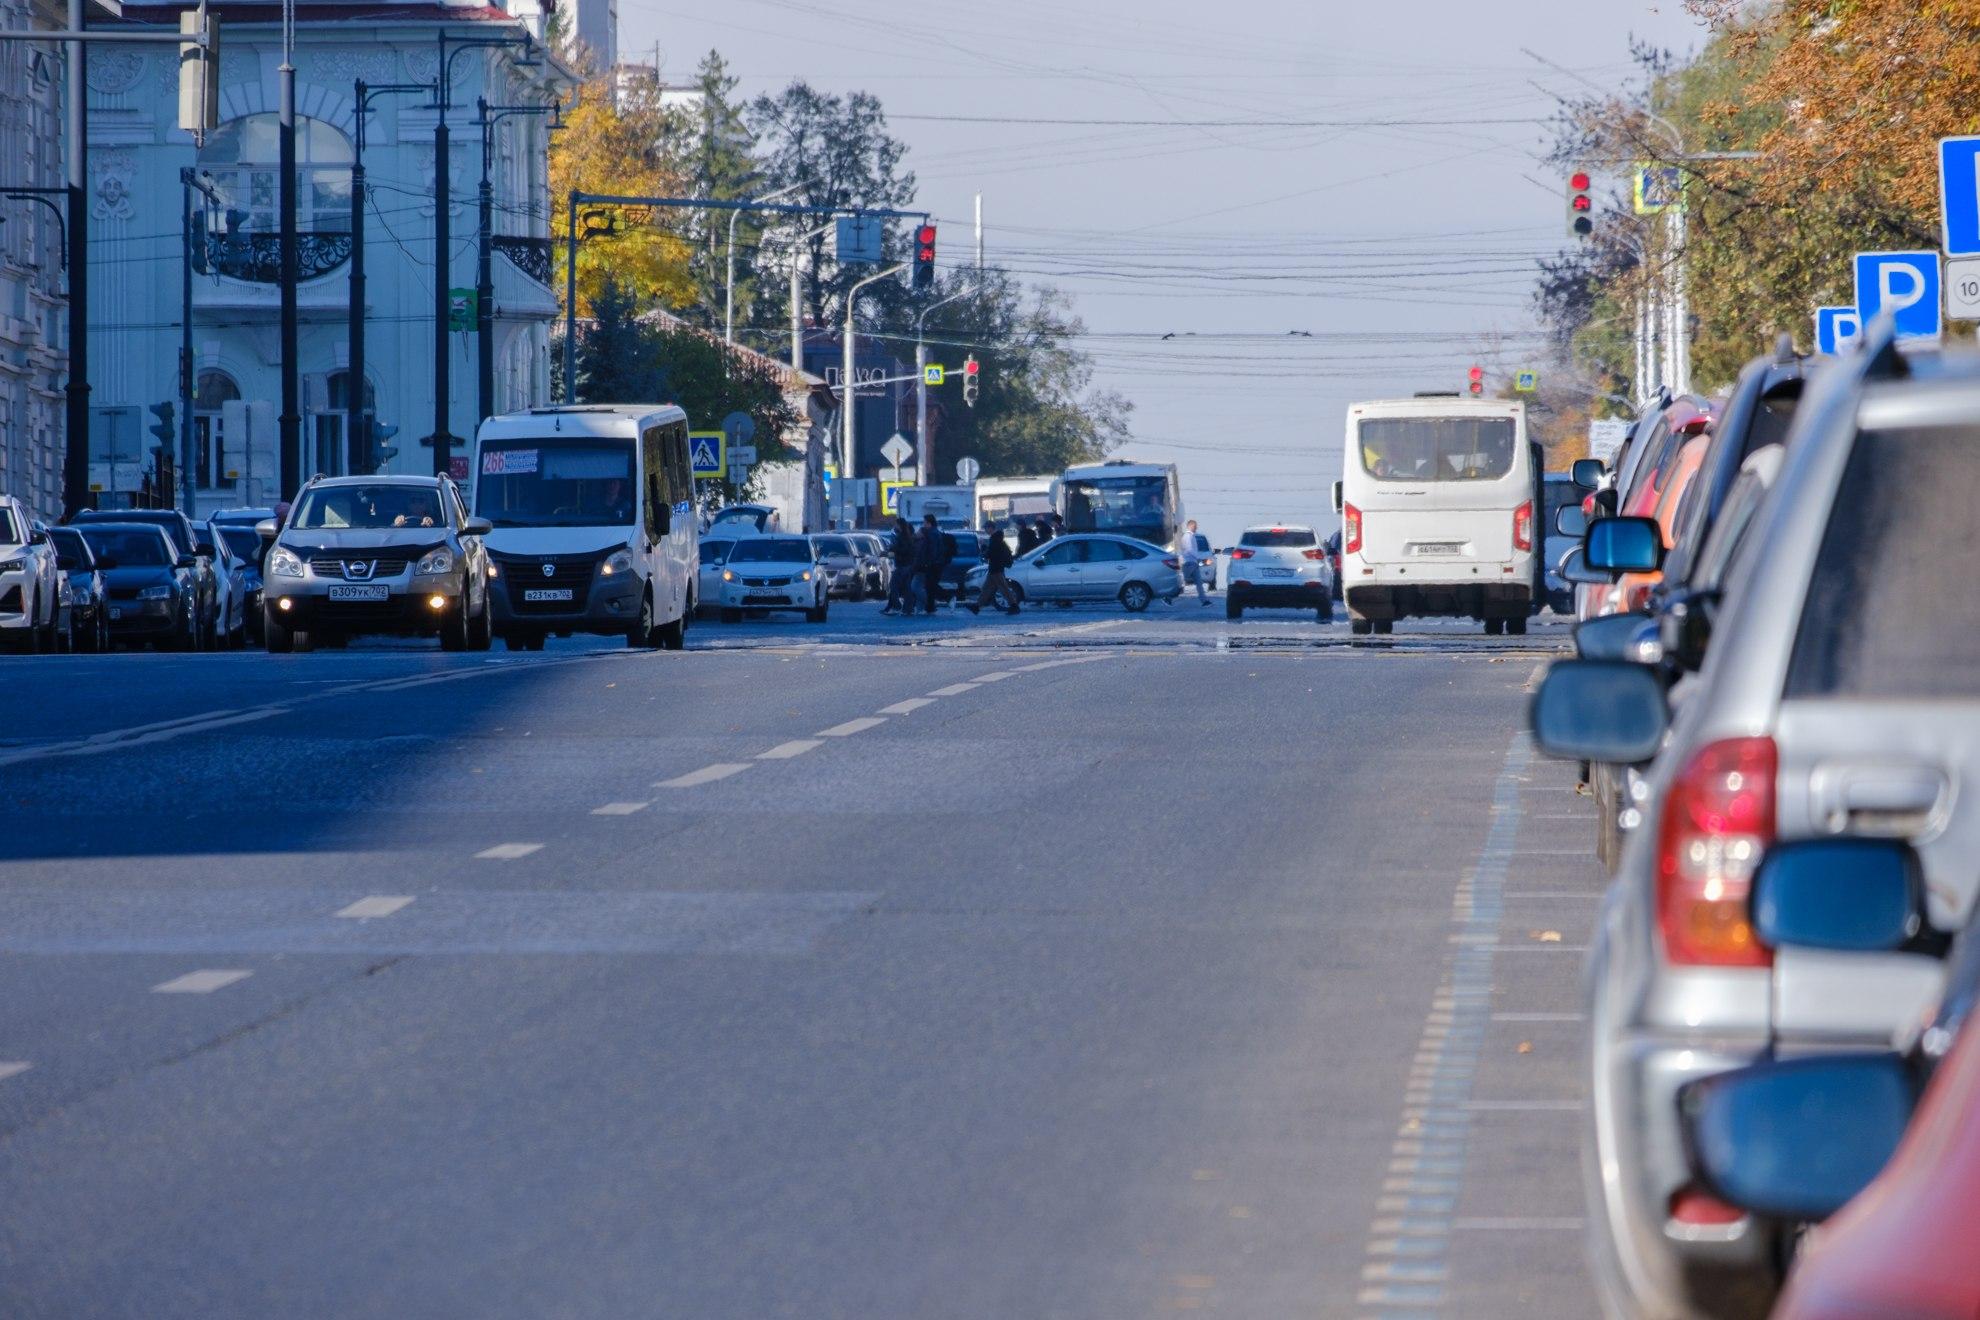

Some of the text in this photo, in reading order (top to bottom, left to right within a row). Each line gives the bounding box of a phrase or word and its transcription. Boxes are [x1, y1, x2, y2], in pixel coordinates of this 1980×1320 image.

[1879, 262, 1926, 318] P
[1961, 281, 1979, 297] 10
[484, 452, 504, 472] 266
